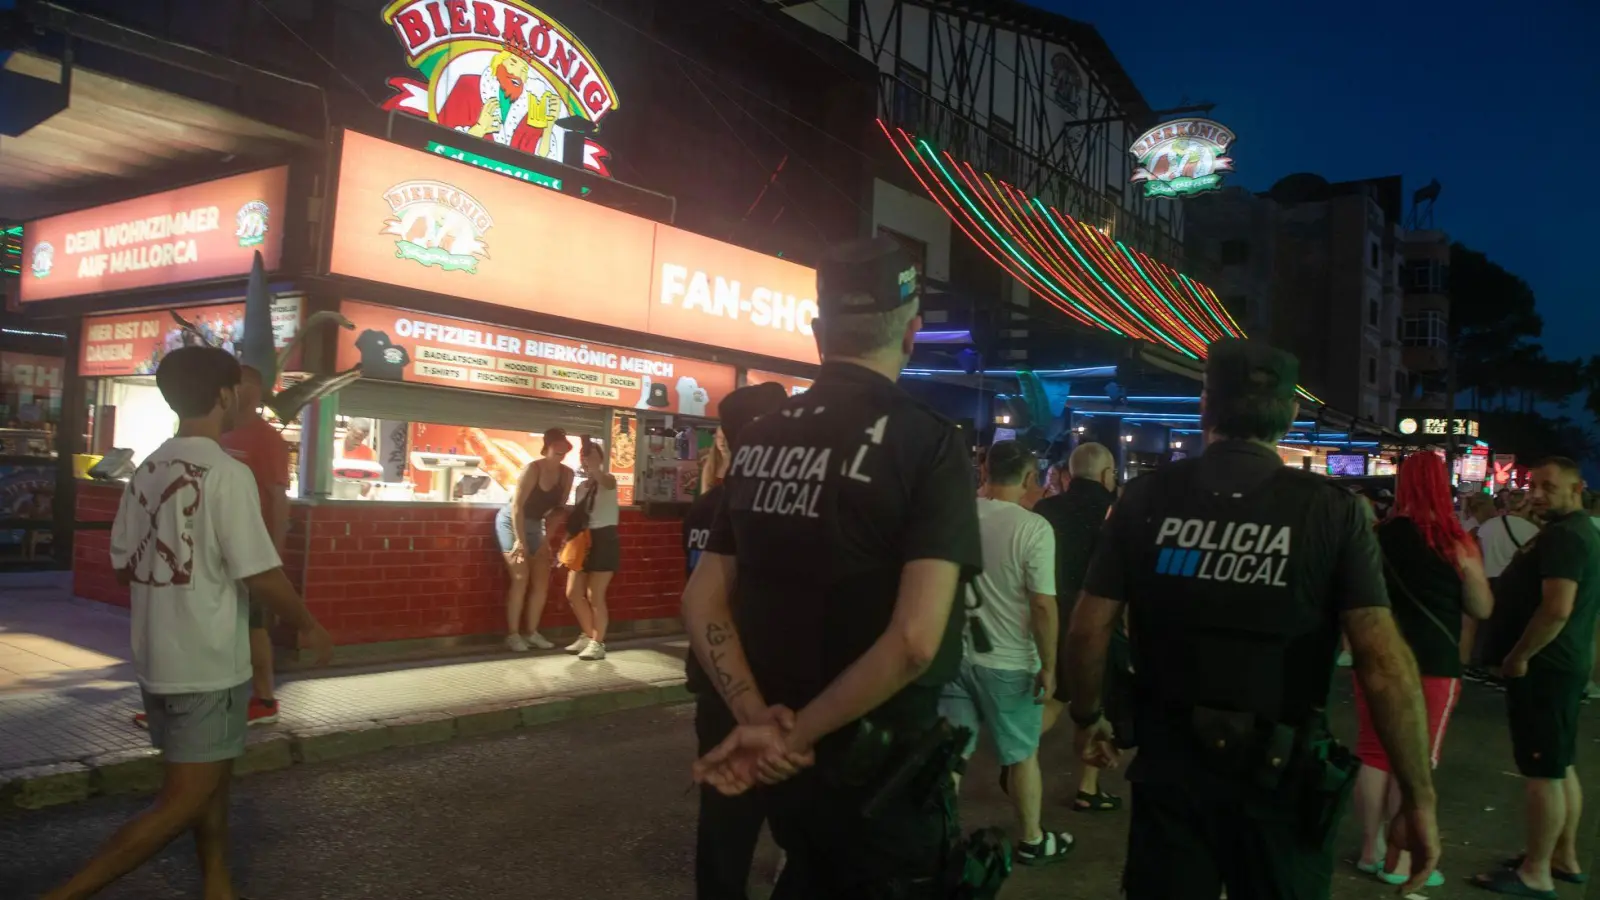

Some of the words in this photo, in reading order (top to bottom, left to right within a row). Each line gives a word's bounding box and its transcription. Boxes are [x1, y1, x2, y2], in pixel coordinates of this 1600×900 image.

[399, 0, 608, 115] BIERKÖNIG
[1133, 121, 1229, 154] BIERKÖNIG
[388, 185, 488, 230] BIERKÖNIG
[65, 229, 101, 254] DEIN
[103, 206, 220, 248] WOHNZIMMER
[78, 254, 108, 278] AUF
[110, 239, 198, 274] MALLORCA
[115, 321, 140, 339] BIST
[142, 320, 160, 338] DU
[394, 318, 520, 355] OFFIZIELLER
[525, 338, 617, 370] BIERKÖNIG
[620, 355, 674, 378] MERCH
[423, 350, 489, 366] BADELATSCHEN
[423, 366, 460, 378] T-SHIRTS
[477, 371, 529, 386] FISCHERHÜTE
[504, 362, 538, 373] HOODIES
[551, 368, 599, 381] HANDTÜCHER
[610, 377, 636, 387] SOCKEN
[730, 445, 832, 482] POLICIA
[752, 480, 822, 518] LOCAL
[1155, 517, 1291, 556] POLICIA
[1198, 551, 1288, 587] LOCAL
